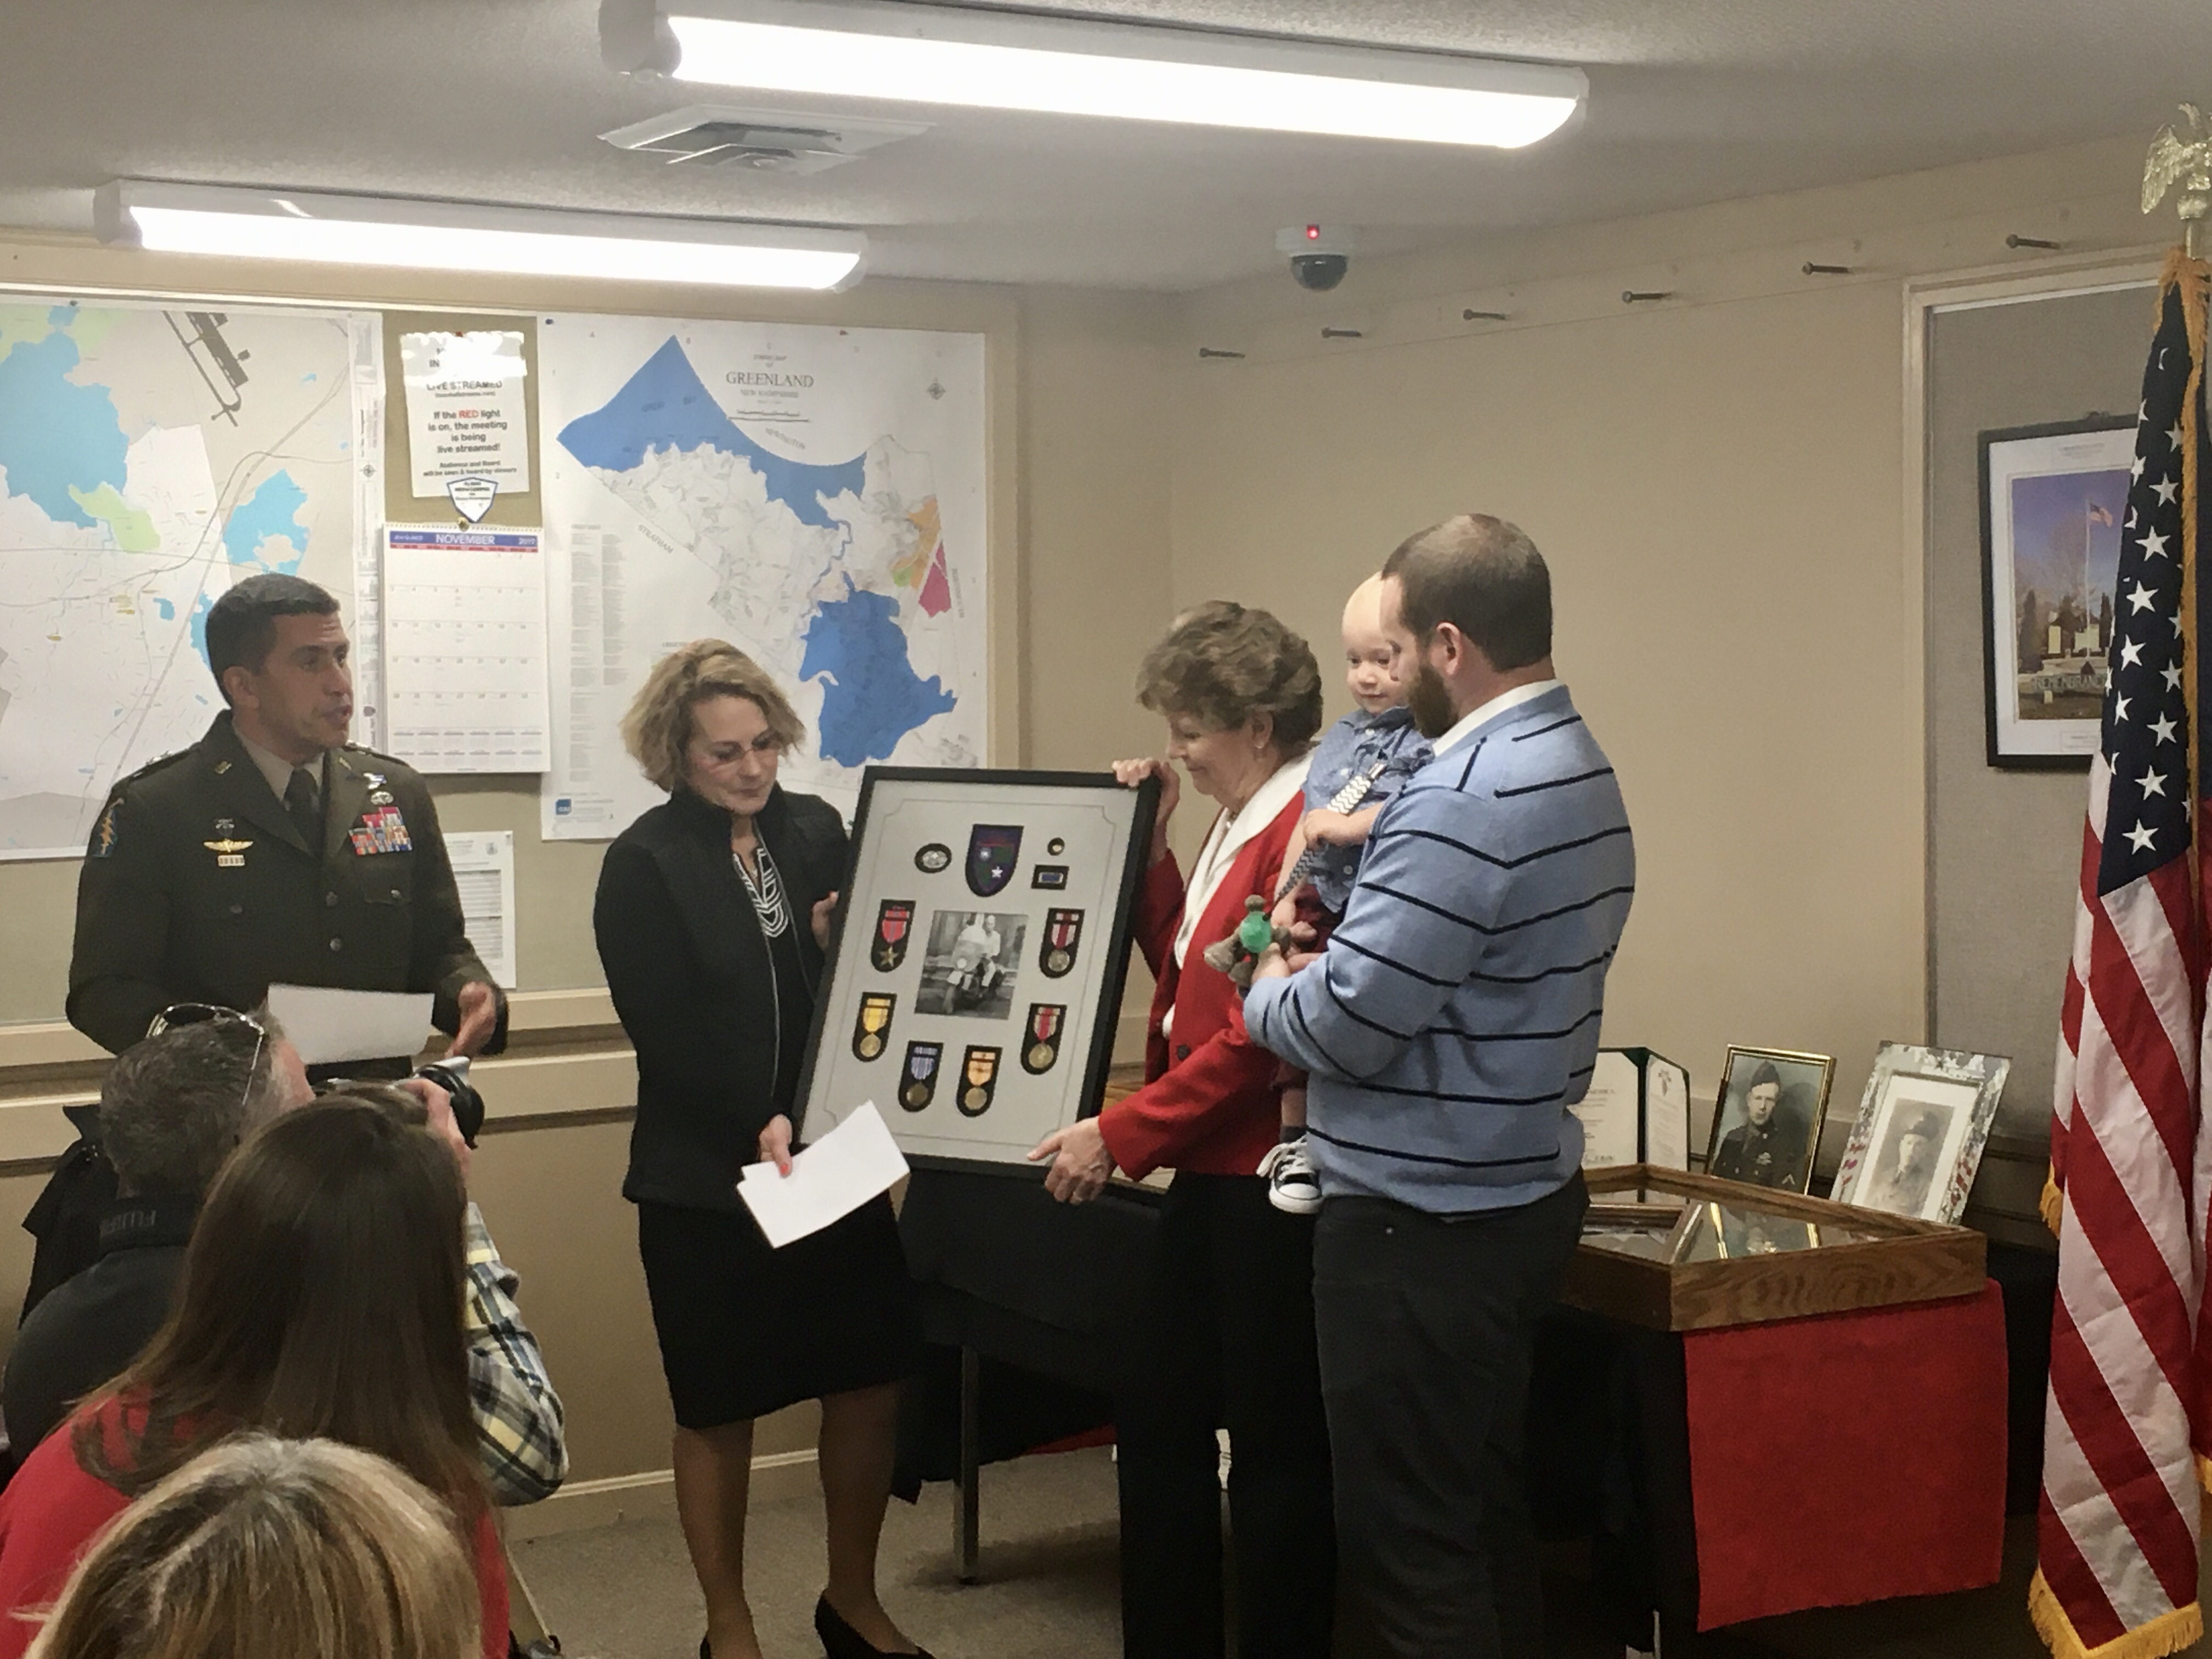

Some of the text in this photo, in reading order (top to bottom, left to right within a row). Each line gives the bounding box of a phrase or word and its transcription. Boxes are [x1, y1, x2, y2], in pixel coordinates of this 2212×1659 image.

[725, 371, 814, 387] GREENLAND
[433, 411, 440, 419] If
[459, 410, 479, 419] RED
[481, 409, 500, 419] light
[454, 422, 469, 430] the
[471, 421, 507, 430] meeting
[461, 433, 486, 442] being
[437, 445, 453, 454] live
[436, 534, 495, 545] NOVEMBER
[2030, 674, 2106, 690] REMEMBRANC
